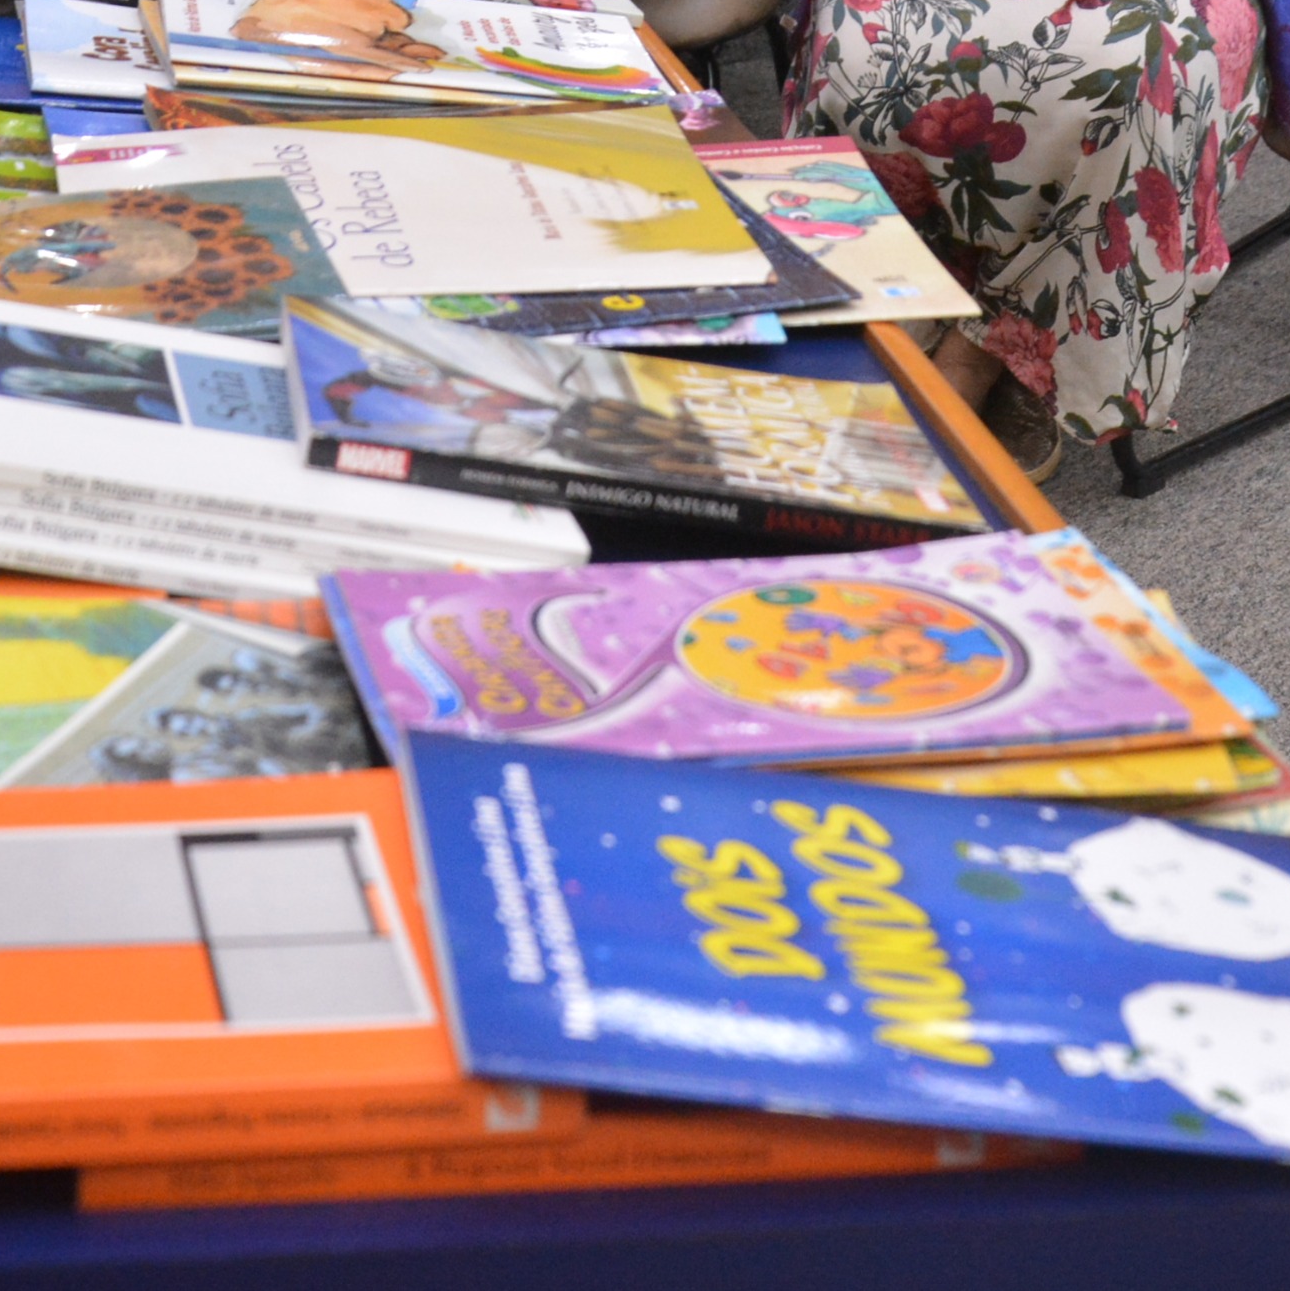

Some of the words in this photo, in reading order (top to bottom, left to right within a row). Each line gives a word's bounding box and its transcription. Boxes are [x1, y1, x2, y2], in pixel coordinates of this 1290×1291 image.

[335, 169, 404, 235] Rebeca
[351, 240, 414, 268] de
[336, 441, 411, 480] MARVEL
[770, 799, 994, 1067] MUNDOS
